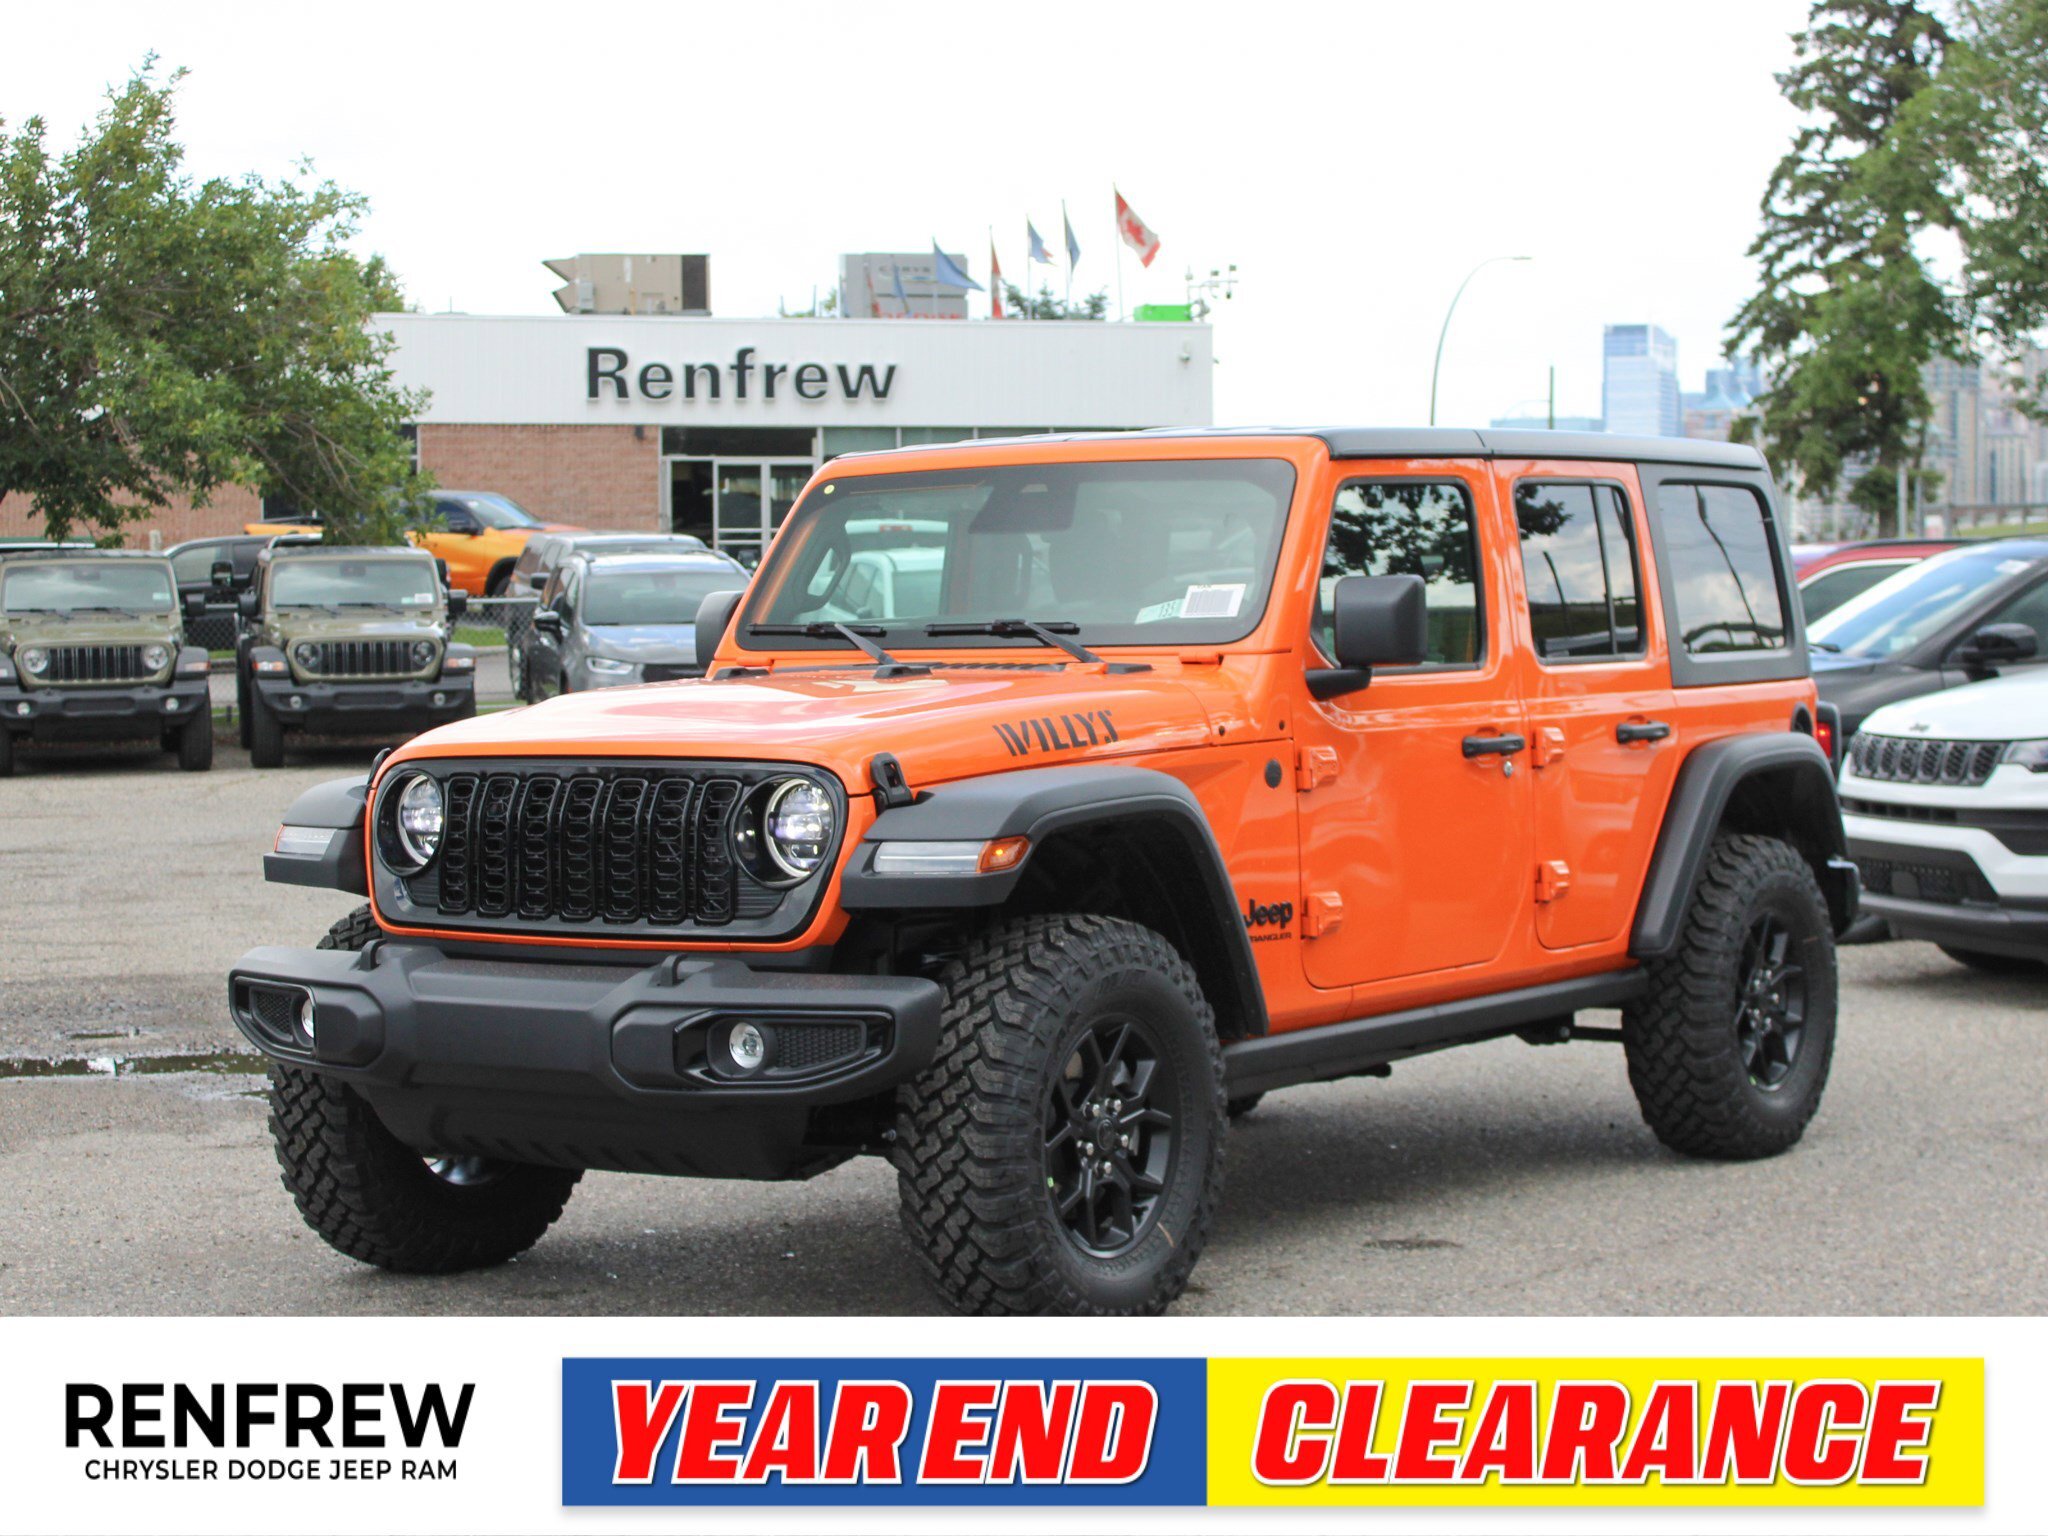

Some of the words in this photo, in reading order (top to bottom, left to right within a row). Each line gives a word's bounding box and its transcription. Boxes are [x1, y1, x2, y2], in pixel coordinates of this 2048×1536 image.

[587, 347, 897, 401] Renfrew
[992, 709, 1119, 757] WILLYS
[1242, 898, 1293, 930] Jeep
[1249, 932, 1292, 943] RANGLER
